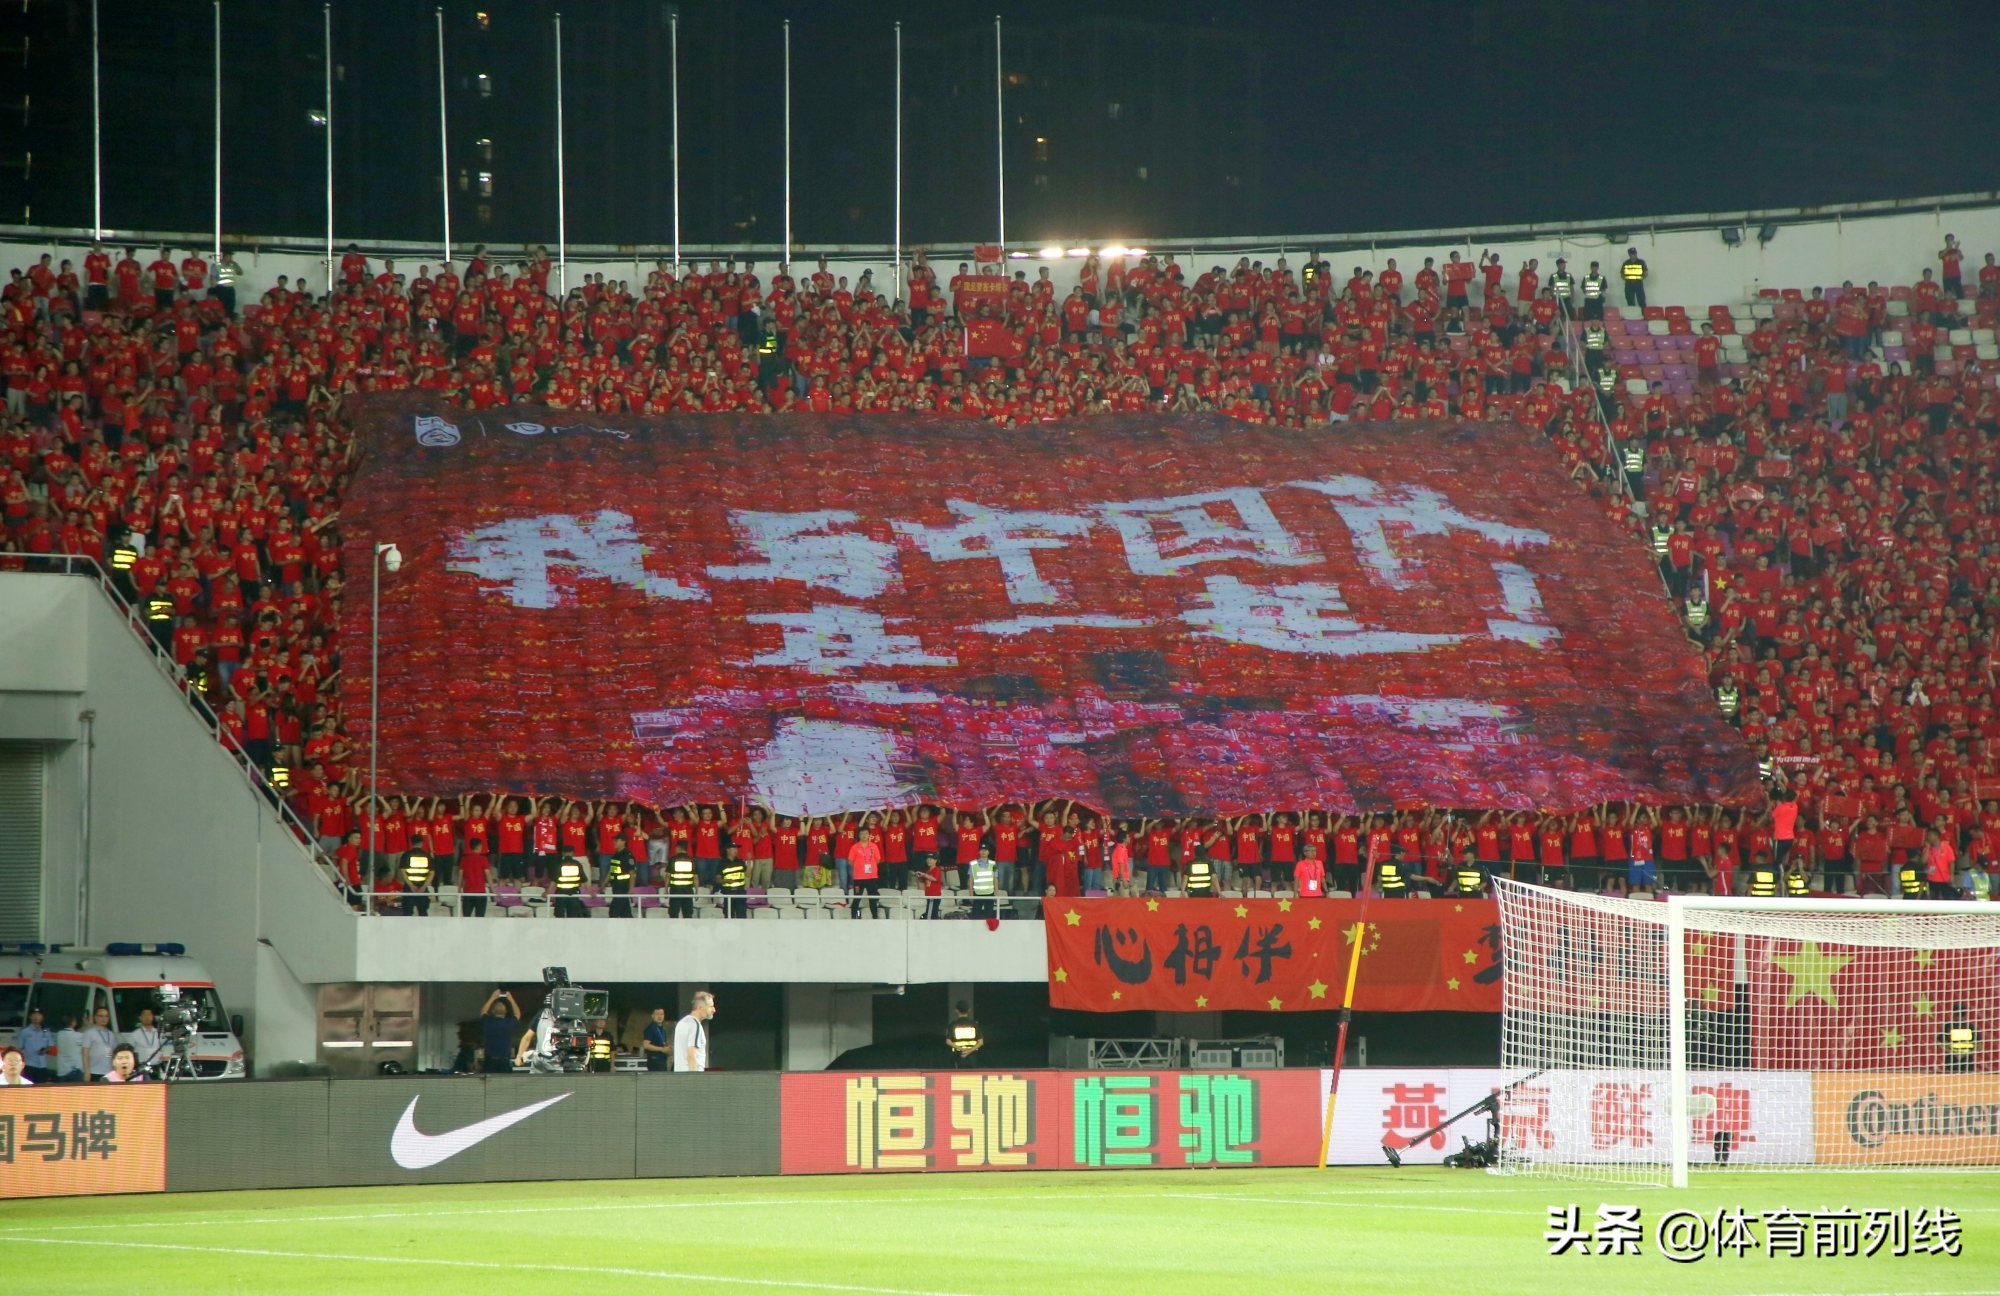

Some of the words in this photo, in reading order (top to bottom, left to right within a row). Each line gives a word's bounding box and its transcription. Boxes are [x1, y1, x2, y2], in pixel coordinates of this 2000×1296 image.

[325, 806, 341, 815] 中国
[387, 822, 400, 830] 中国
[435, 824, 449, 833] 中国
[472, 823, 484, 832] 中国
[506, 822, 522, 831] 中国
[570, 826, 584, 835] 中国
[606, 823, 620, 832] 中国
[1578, 823, 1590, 832] 中国
[415, 827, 428, 835] 中国
[672, 829, 688, 839] 中国
[701, 828, 715, 837] 中国
[841, 831, 854, 839] 中国
[919, 827, 935, 835] 中国
[1482, 831, 1496, 840] 中国
[1609, 830, 1621, 838] 中国
[1668, 829, 1683, 837] 中国
[1697, 829, 1708, 839] 中国
[781, 835, 796, 844] 中国
[812, 835, 826, 844] 中国
[890, 832, 903, 842] 中国
[962, 833, 977, 841] 中国
[1001, 833, 1014, 841] 中国
[1242, 832, 1256, 841] 中国
[1276, 834, 1290, 842] 中国
[1310, 833, 1324, 843] 中国
[1341, 834, 1356, 843] 中国
[1403, 832, 1418, 842] 中国
[1516, 832, 1530, 841] 中国
[1828, 836, 1842, 846] 中国
[1086, 839, 1098, 848] 中国
[1153, 838, 1167, 846] 中国
[1455, 837, 1470, 846] 中国
[1548, 838, 1560, 847] 中国
[1094, 922, 1293, 985] 心相伴
[846, 1075, 1029, 1169] 恒驰
[1074, 1074, 1254, 1167] 恒驰
